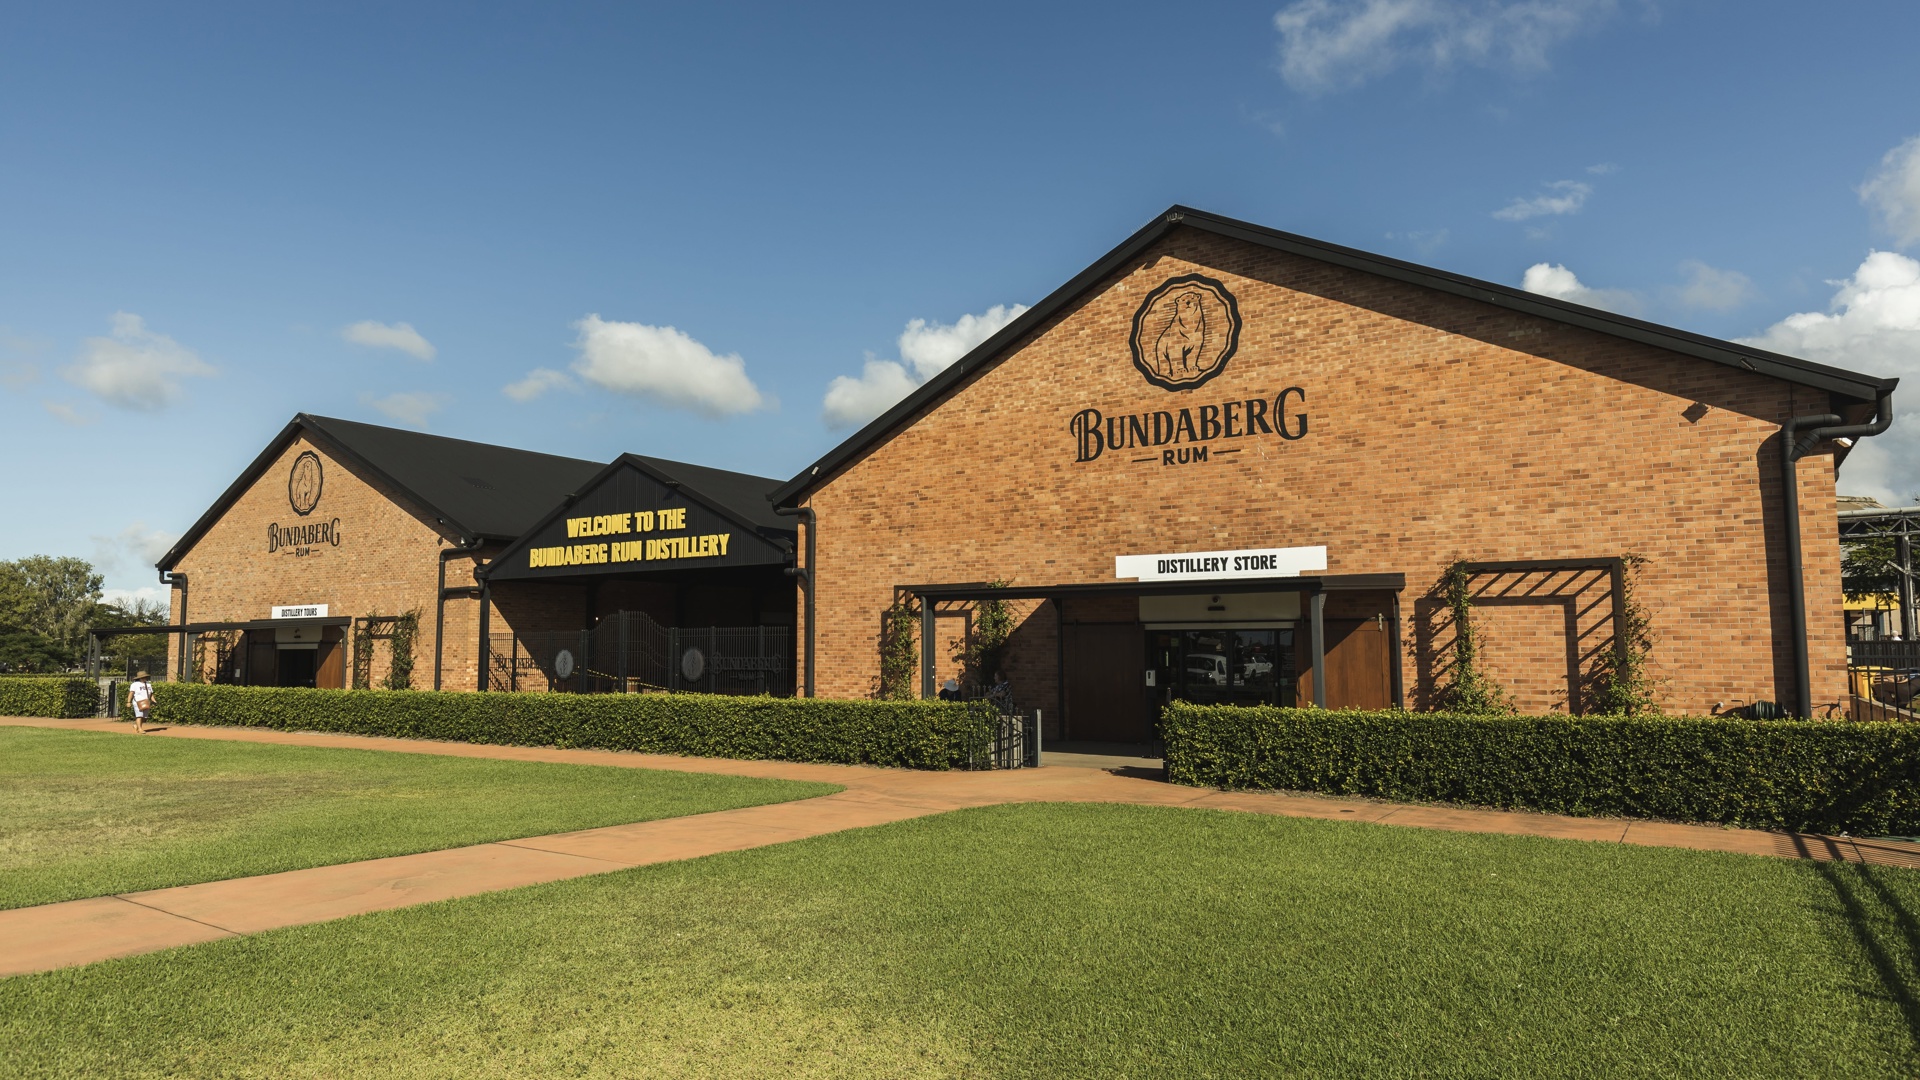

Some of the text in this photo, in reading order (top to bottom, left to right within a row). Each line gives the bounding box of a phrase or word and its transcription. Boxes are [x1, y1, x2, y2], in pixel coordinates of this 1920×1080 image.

[1069, 386, 1309, 463] BUNDABERG
[1162, 445, 1208, 466] RUM
[267, 517, 341, 553] BUNDABERG
[567, 508, 686, 538] WELCOME TO THE
[295, 547, 310, 557] RUM
[529, 533, 730, 568] BUNDABERG RUM DISTILLERY
[1157, 554, 1277, 574] DISTILLERY STORE
[281, 608, 317, 617] DISTILLERY TOURS
